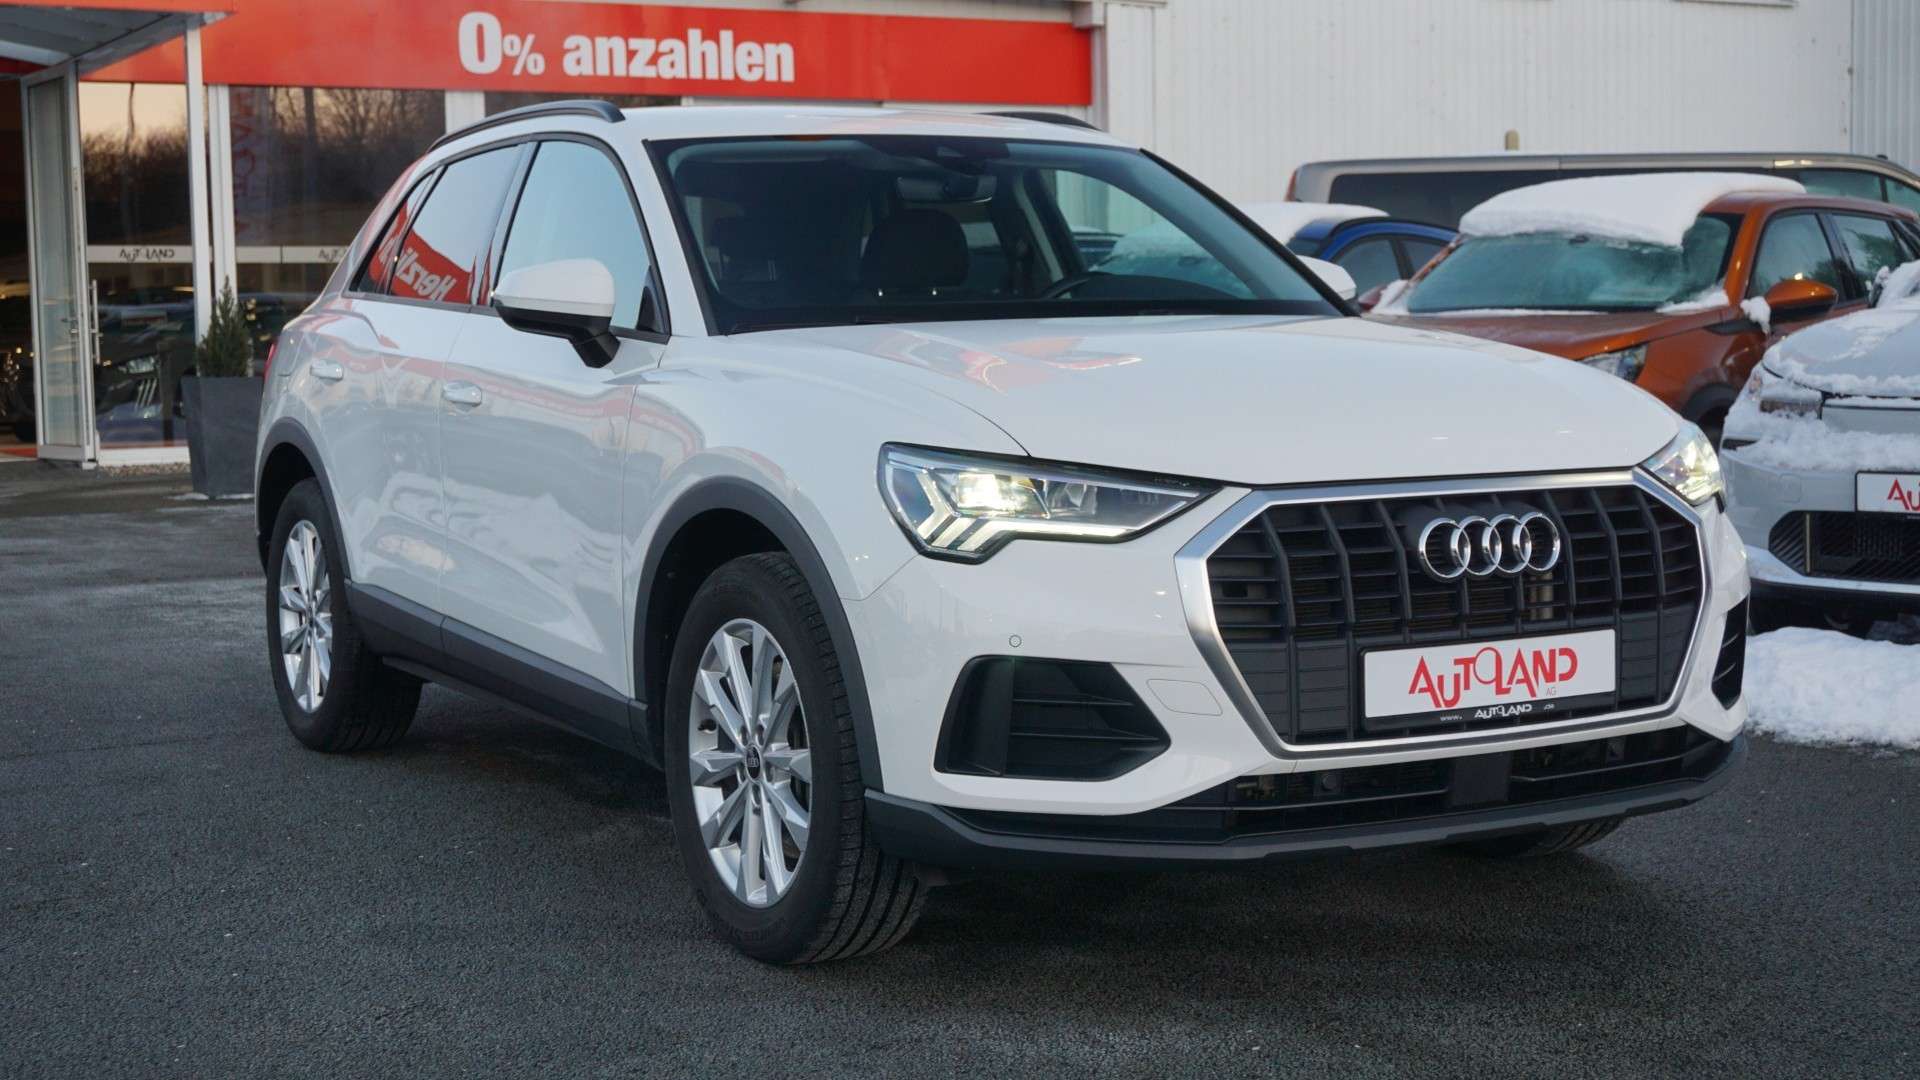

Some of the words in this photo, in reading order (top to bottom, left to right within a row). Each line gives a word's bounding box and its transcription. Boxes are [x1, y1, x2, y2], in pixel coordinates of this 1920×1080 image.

[458, 11, 546, 76] 0%
[563, 28, 795, 82] anzahlen
[119, 248, 175, 264] AUTLAND
